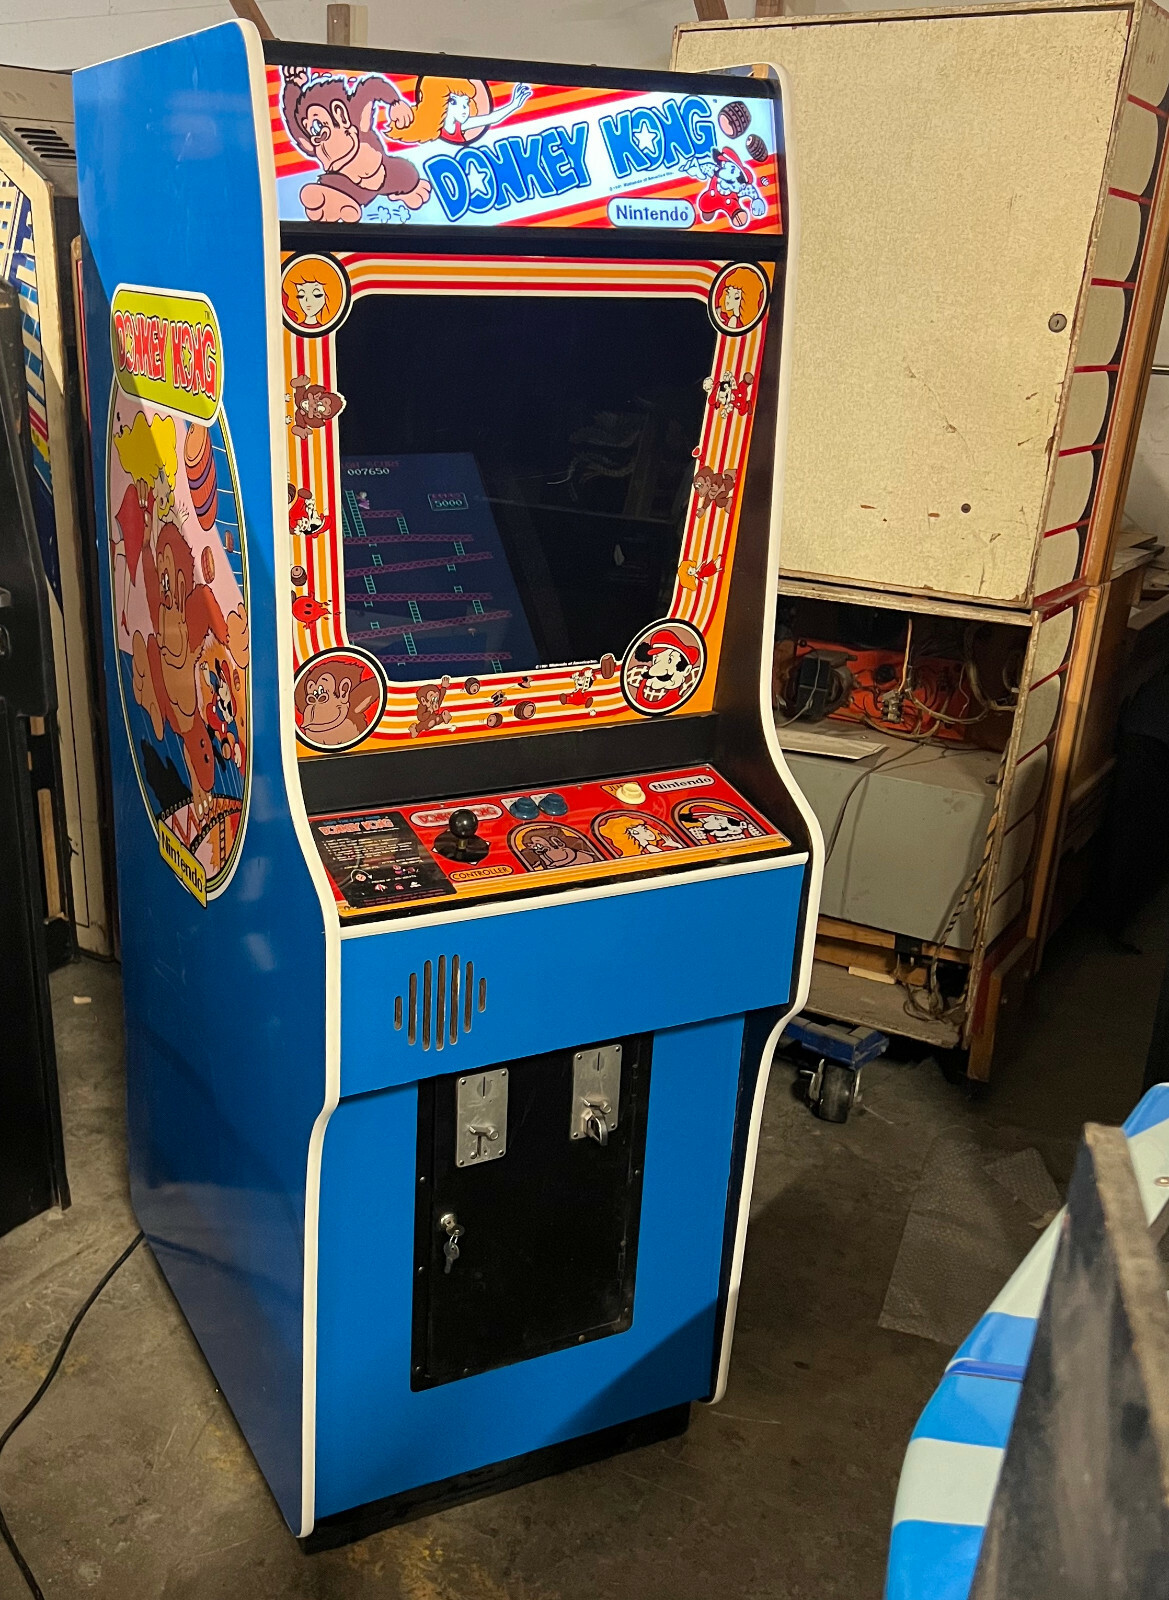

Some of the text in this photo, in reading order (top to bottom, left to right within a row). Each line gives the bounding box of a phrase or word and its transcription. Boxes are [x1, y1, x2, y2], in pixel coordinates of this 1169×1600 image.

[422, 94, 718, 223] DONKEY KONG
[615, 204, 689, 221] Nintendo
[113, 309, 168, 382] DONKEY
[170, 320, 217, 402] KONG
[347, 467, 390, 476] 007650
[434, 499, 463, 508] 5000
[653, 777, 712, 791] Nintendo
[160, 830, 204, 893] Nintendo
[452, 866, 509, 880] CONTROLLER
